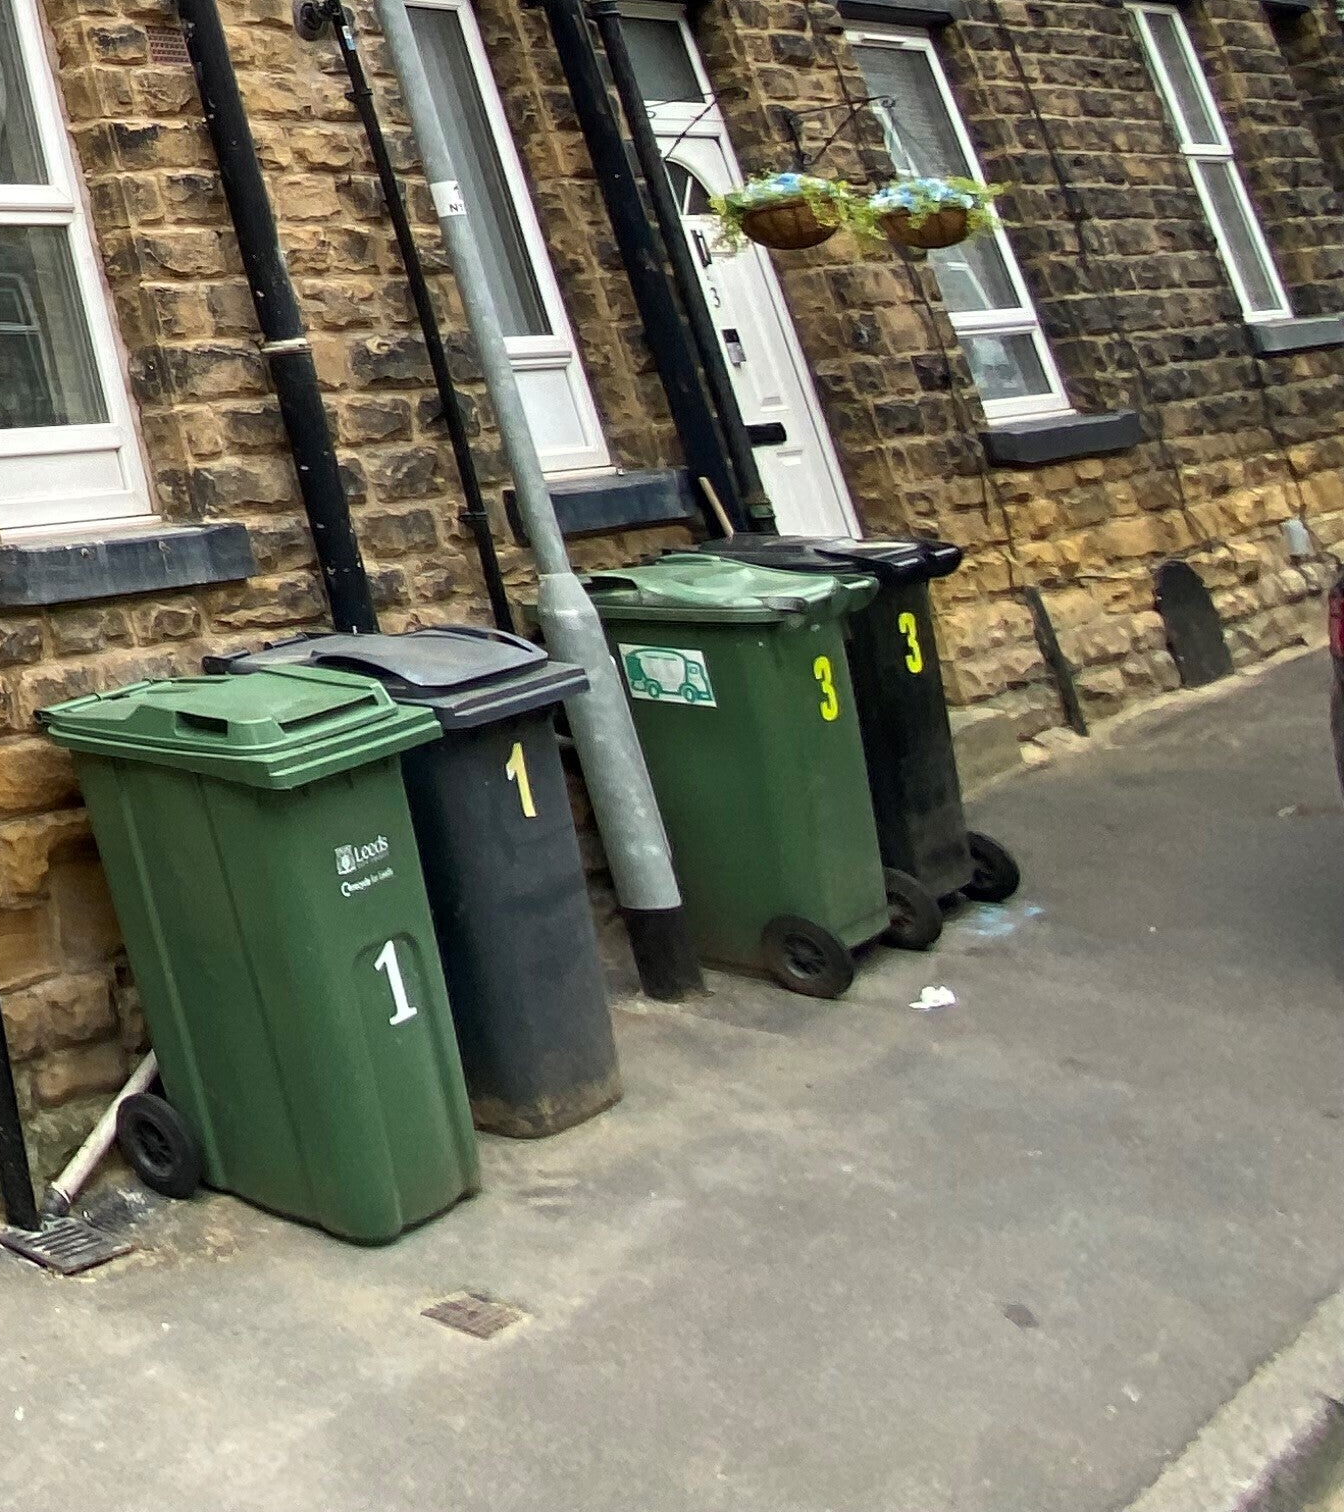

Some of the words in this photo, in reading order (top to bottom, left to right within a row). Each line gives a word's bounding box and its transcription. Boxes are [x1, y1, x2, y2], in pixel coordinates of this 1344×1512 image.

[710, 287, 721, 309] 3
[898, 612, 923, 674] 3
[813, 656, 838, 721] 3
[505, 742, 537, 817] 1
[353, 834, 389, 863] Leeds
[374, 940, 418, 1025] 1
